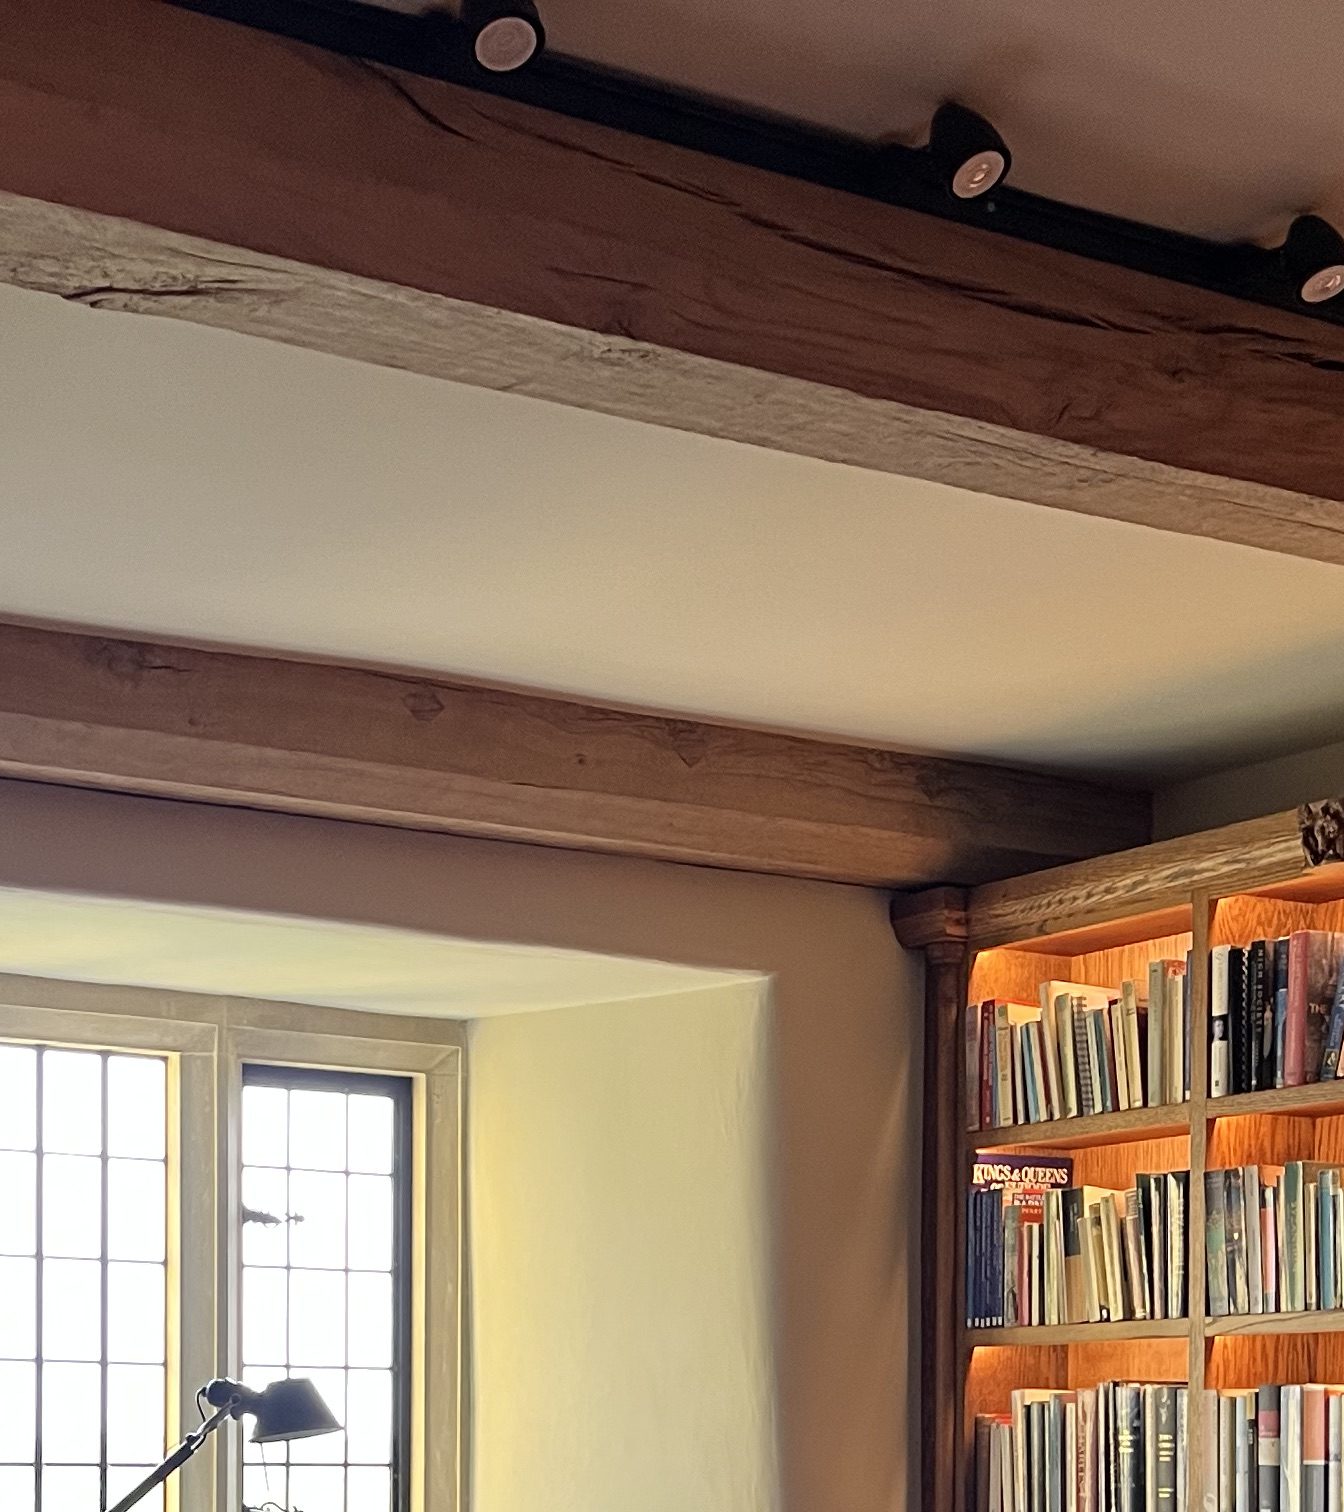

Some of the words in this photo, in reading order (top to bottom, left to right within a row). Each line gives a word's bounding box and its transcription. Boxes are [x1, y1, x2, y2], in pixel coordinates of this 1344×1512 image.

[972, 1164, 1011, 1184] KINGS
[1011, 1168, 1021, 1181] &
[1022, 1166, 1068, 1184] QUEENS
